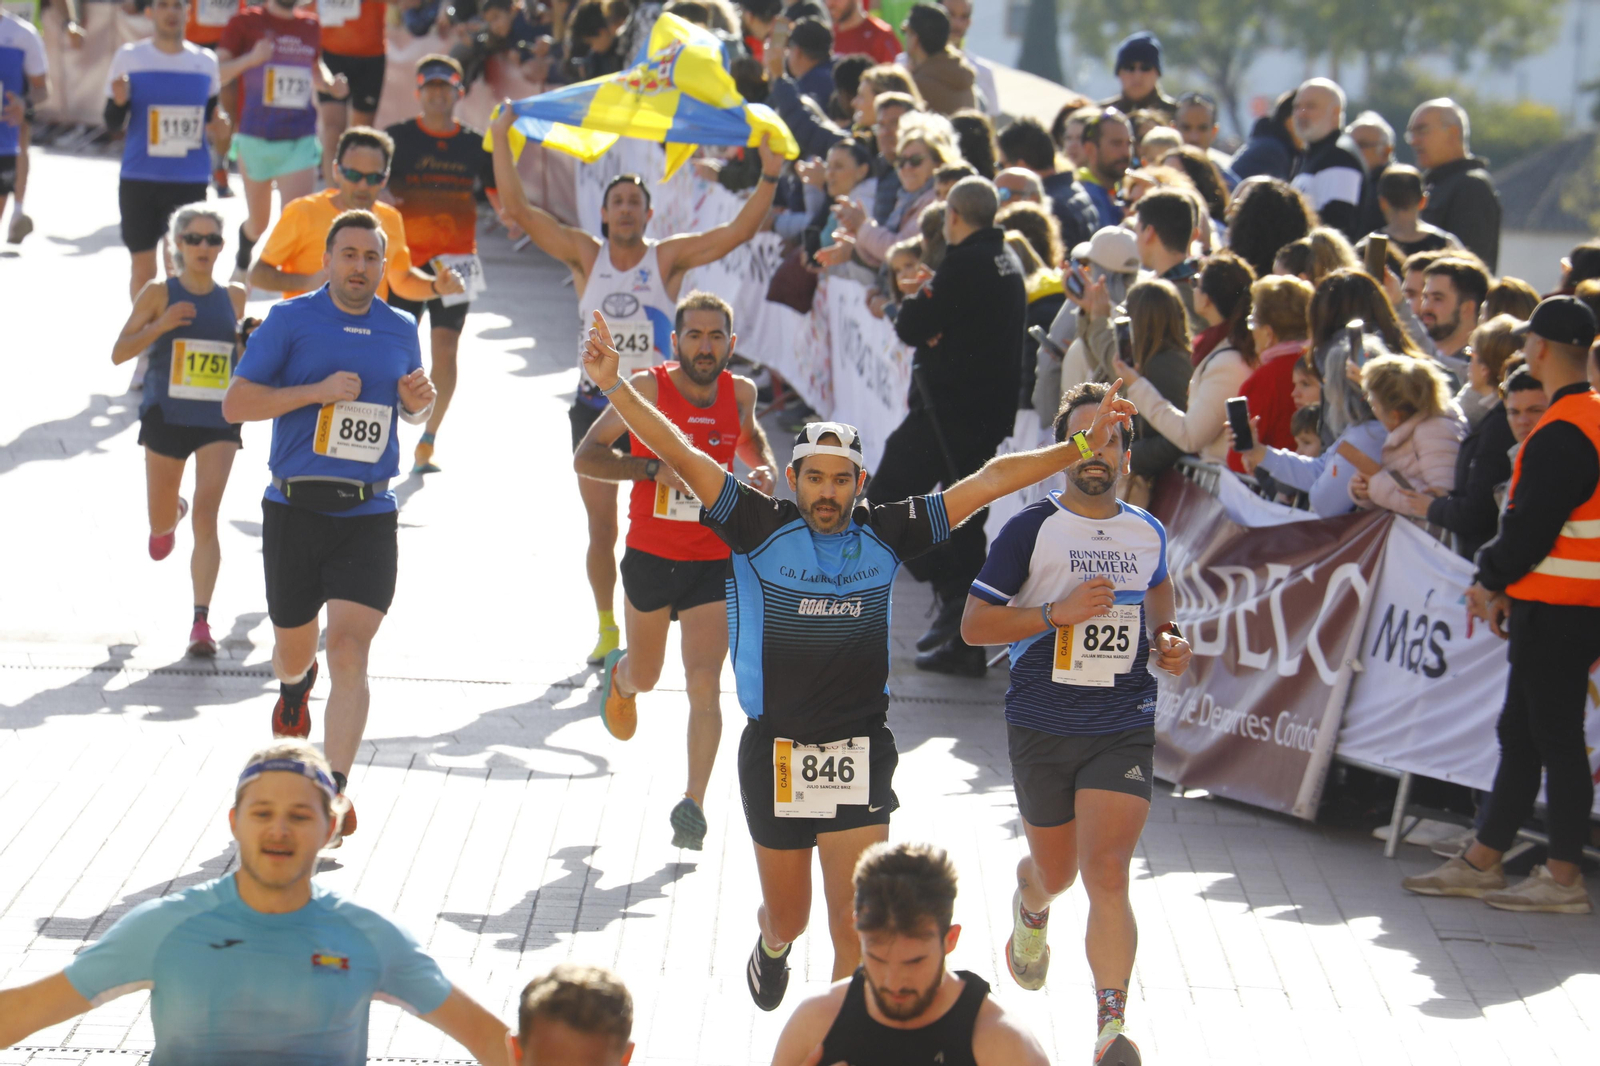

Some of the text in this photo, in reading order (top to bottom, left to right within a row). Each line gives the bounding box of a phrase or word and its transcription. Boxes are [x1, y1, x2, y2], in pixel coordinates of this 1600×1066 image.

[163, 117, 200, 136] 1197
[187, 353, 228, 374] 1757
[339, 417, 381, 444] 889
[1069, 550, 1137, 561] RUNNERS LA
[1070, 559, 1139, 574] PALMERA
[780, 565, 797, 579] C.D.
[1061, 630, 1069, 656] CAJÓN
[1083, 624, 1130, 652] 825
[1198, 693, 1271, 743] Deportes
[780, 762, 788, 788] CAJÓN
[801, 754, 855, 783] 846
[1124, 773, 1146, 782] adidas
